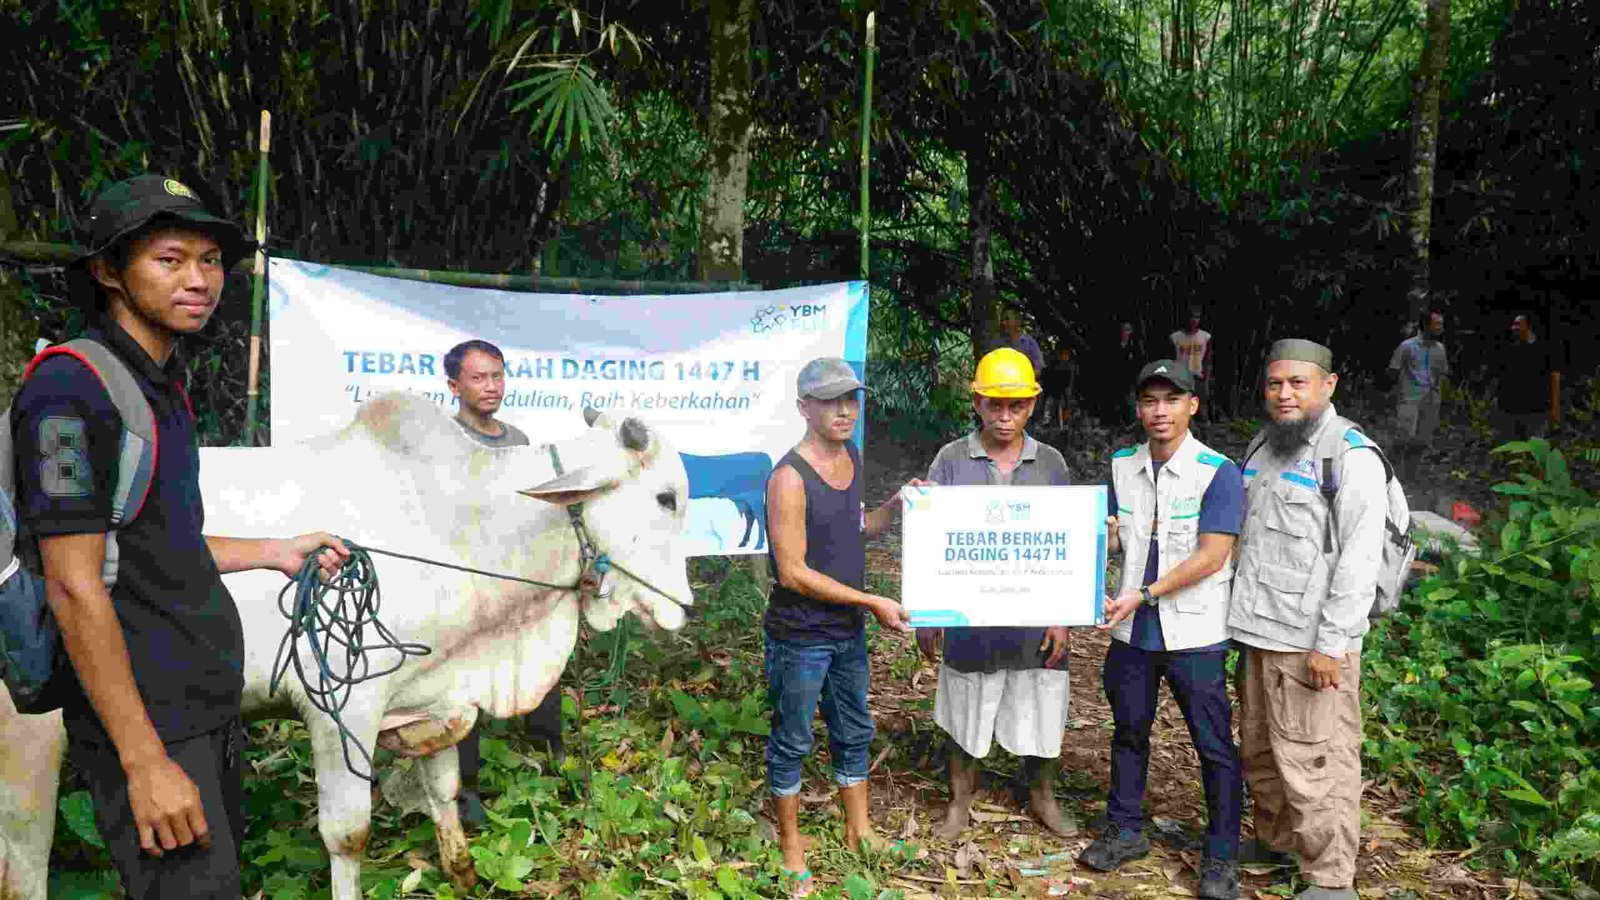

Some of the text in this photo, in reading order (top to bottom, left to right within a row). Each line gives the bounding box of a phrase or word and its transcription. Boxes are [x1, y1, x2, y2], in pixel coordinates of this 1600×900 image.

[790, 305, 827, 317] YBM
[343, 350, 436, 376] TEBAR
[561, 358, 666, 381] DAGING
[674, 360, 735, 381] 1447
[742, 360, 761, 381] H
[946, 531, 1066, 546] TEBAR BERKAH
[945, 547, 1067, 561] DAGING 1447 H
